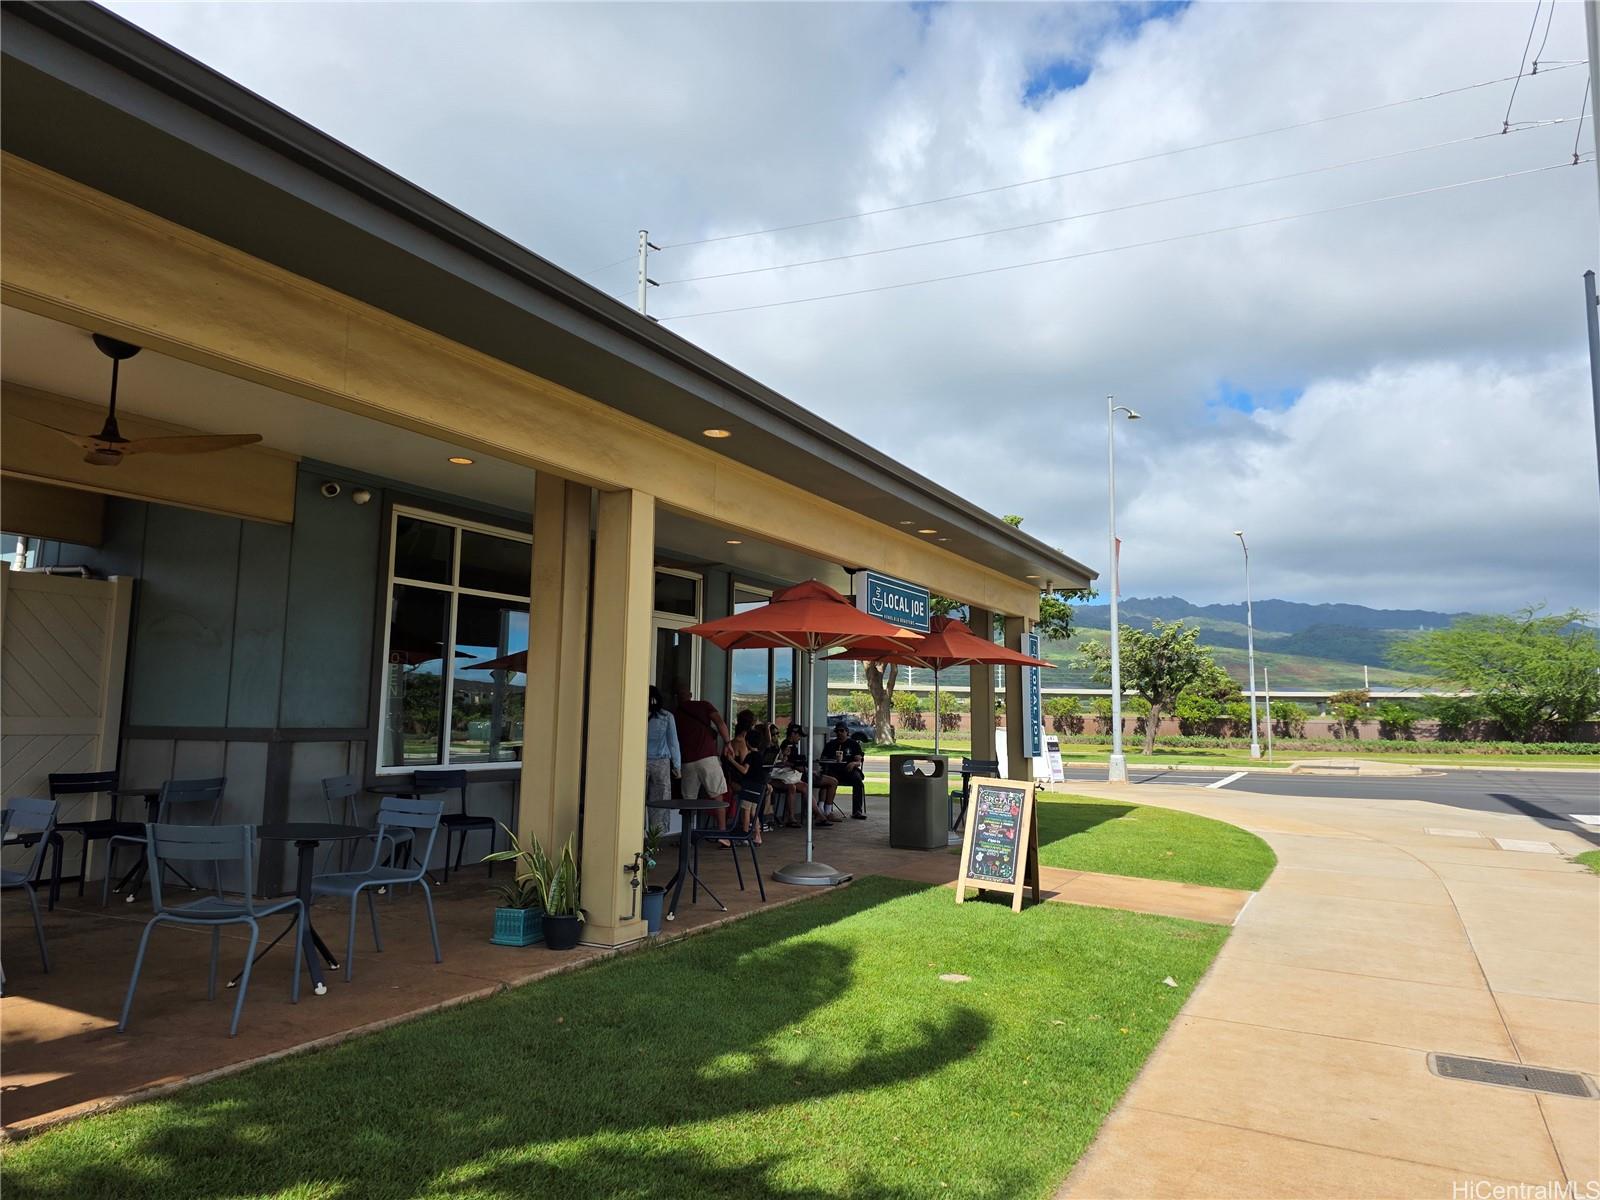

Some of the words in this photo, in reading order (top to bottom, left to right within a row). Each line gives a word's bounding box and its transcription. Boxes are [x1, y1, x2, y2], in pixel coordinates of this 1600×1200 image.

[883, 592, 909, 613] LOCAL
[911, 599, 924, 617] JOE
[388, 652, 400, 698] OPEN
[1031, 720, 1039, 745] JOE
